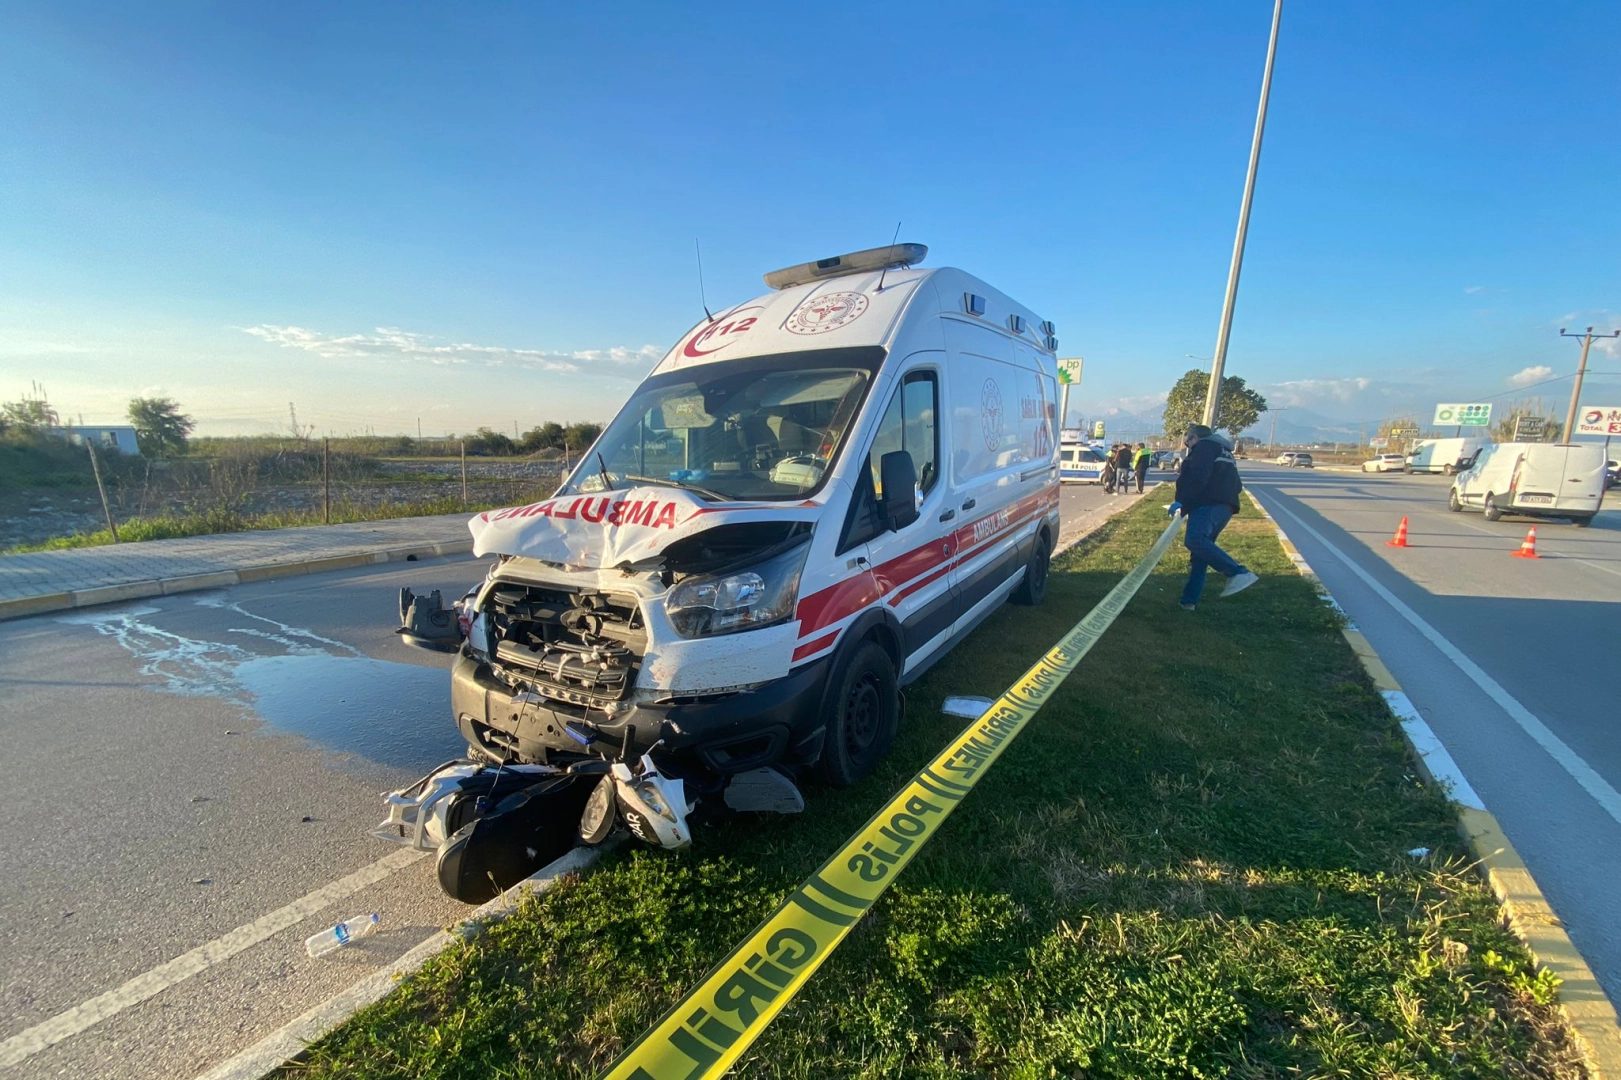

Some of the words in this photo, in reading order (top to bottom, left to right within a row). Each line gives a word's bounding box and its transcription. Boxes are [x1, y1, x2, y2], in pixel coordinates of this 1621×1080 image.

[704, 317, 758, 341] 112
[1066, 359, 1080, 370] bp
[1580, 424, 1604, 432] TOTAL
